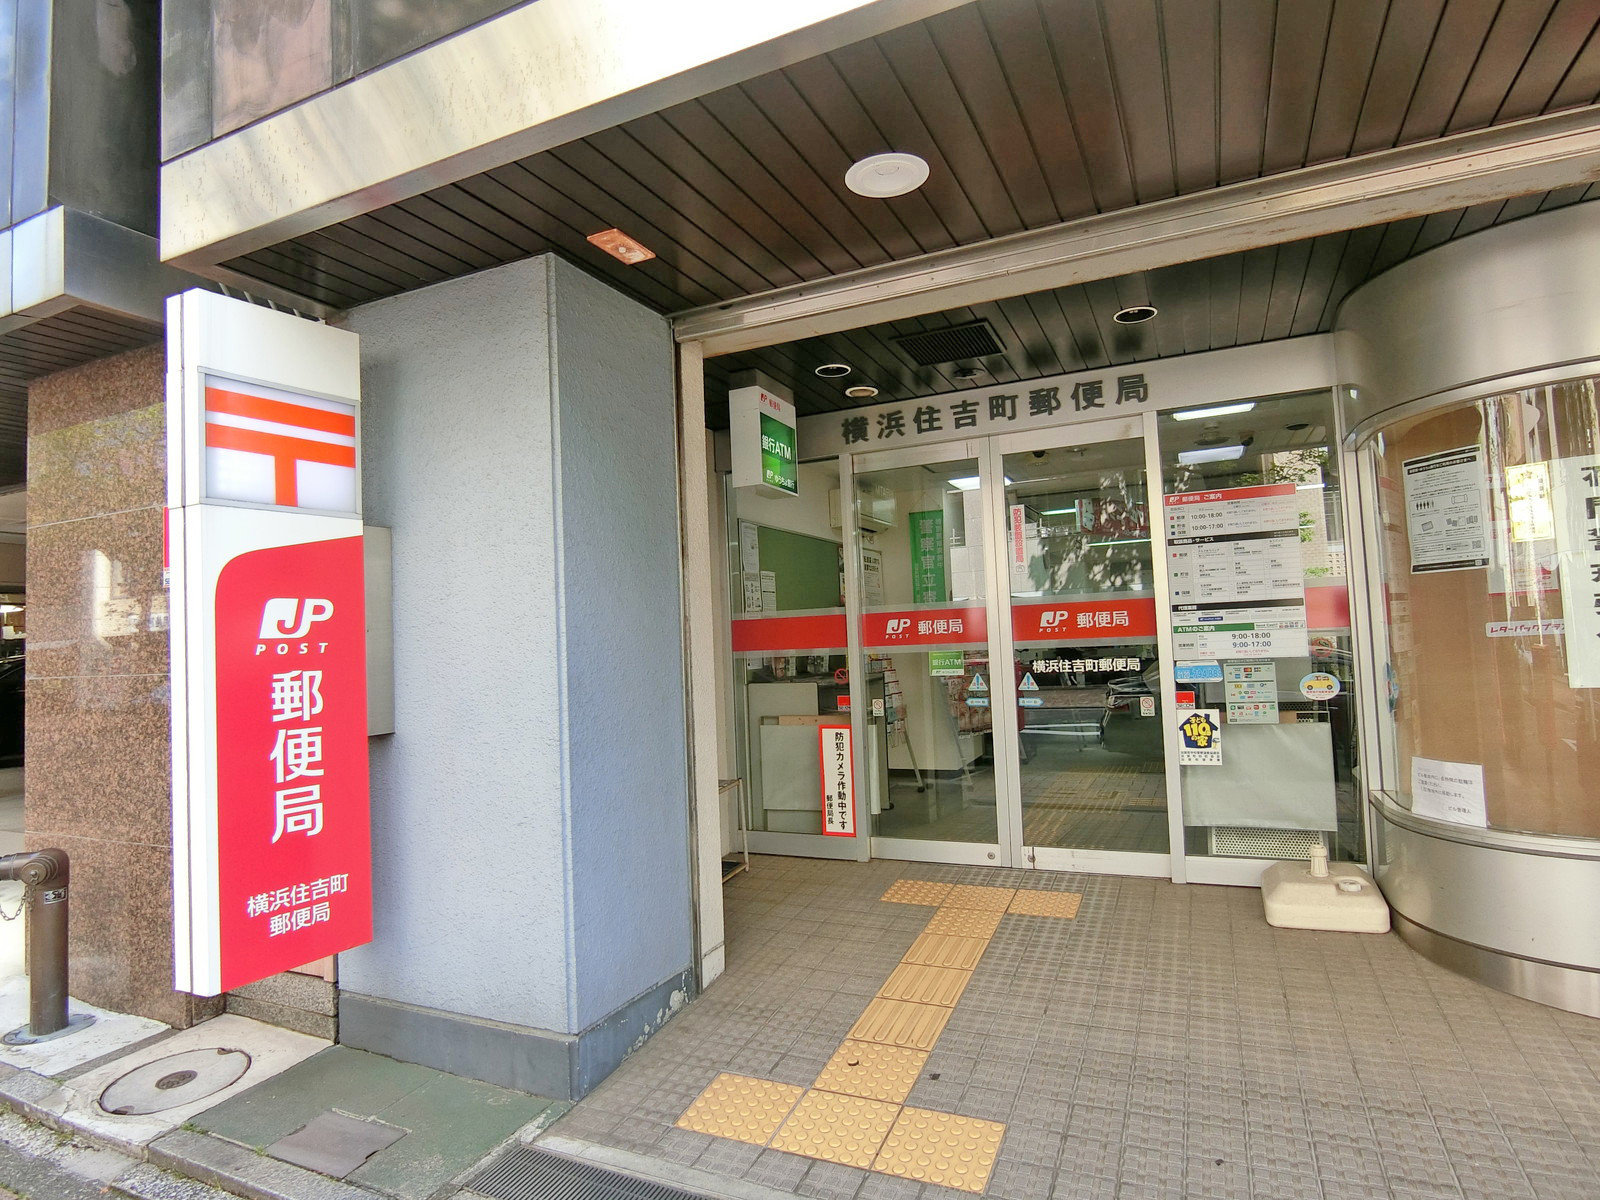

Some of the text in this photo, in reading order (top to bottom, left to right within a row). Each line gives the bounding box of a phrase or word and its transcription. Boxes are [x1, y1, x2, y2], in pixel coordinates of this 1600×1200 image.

[841, 373, 1148, 445] 横浜住吉町郵便局
[762, 434, 791, 460] 銀行ATM
[1191, 512, 1223, 520] 10:00-18:00
[917, 619, 964, 635] 郵便局
[1076, 611, 1129, 628] 郵便局
[1231, 632, 1271, 640] 9:00-18:00
[255, 642, 329, 656] POST
[932, 658, 962, 666] 銀行ATM
[1032, 658, 1141, 674] 横浜住吉町郵便局
[270, 670, 325, 844] 郵便局
[834, 731, 848, 830] 防犯カメラ作動中です
[826, 794, 834, 825] 郵便局長
[246, 872, 349, 918] 横浜住吉町
[269, 901, 331, 938] 郵便局
